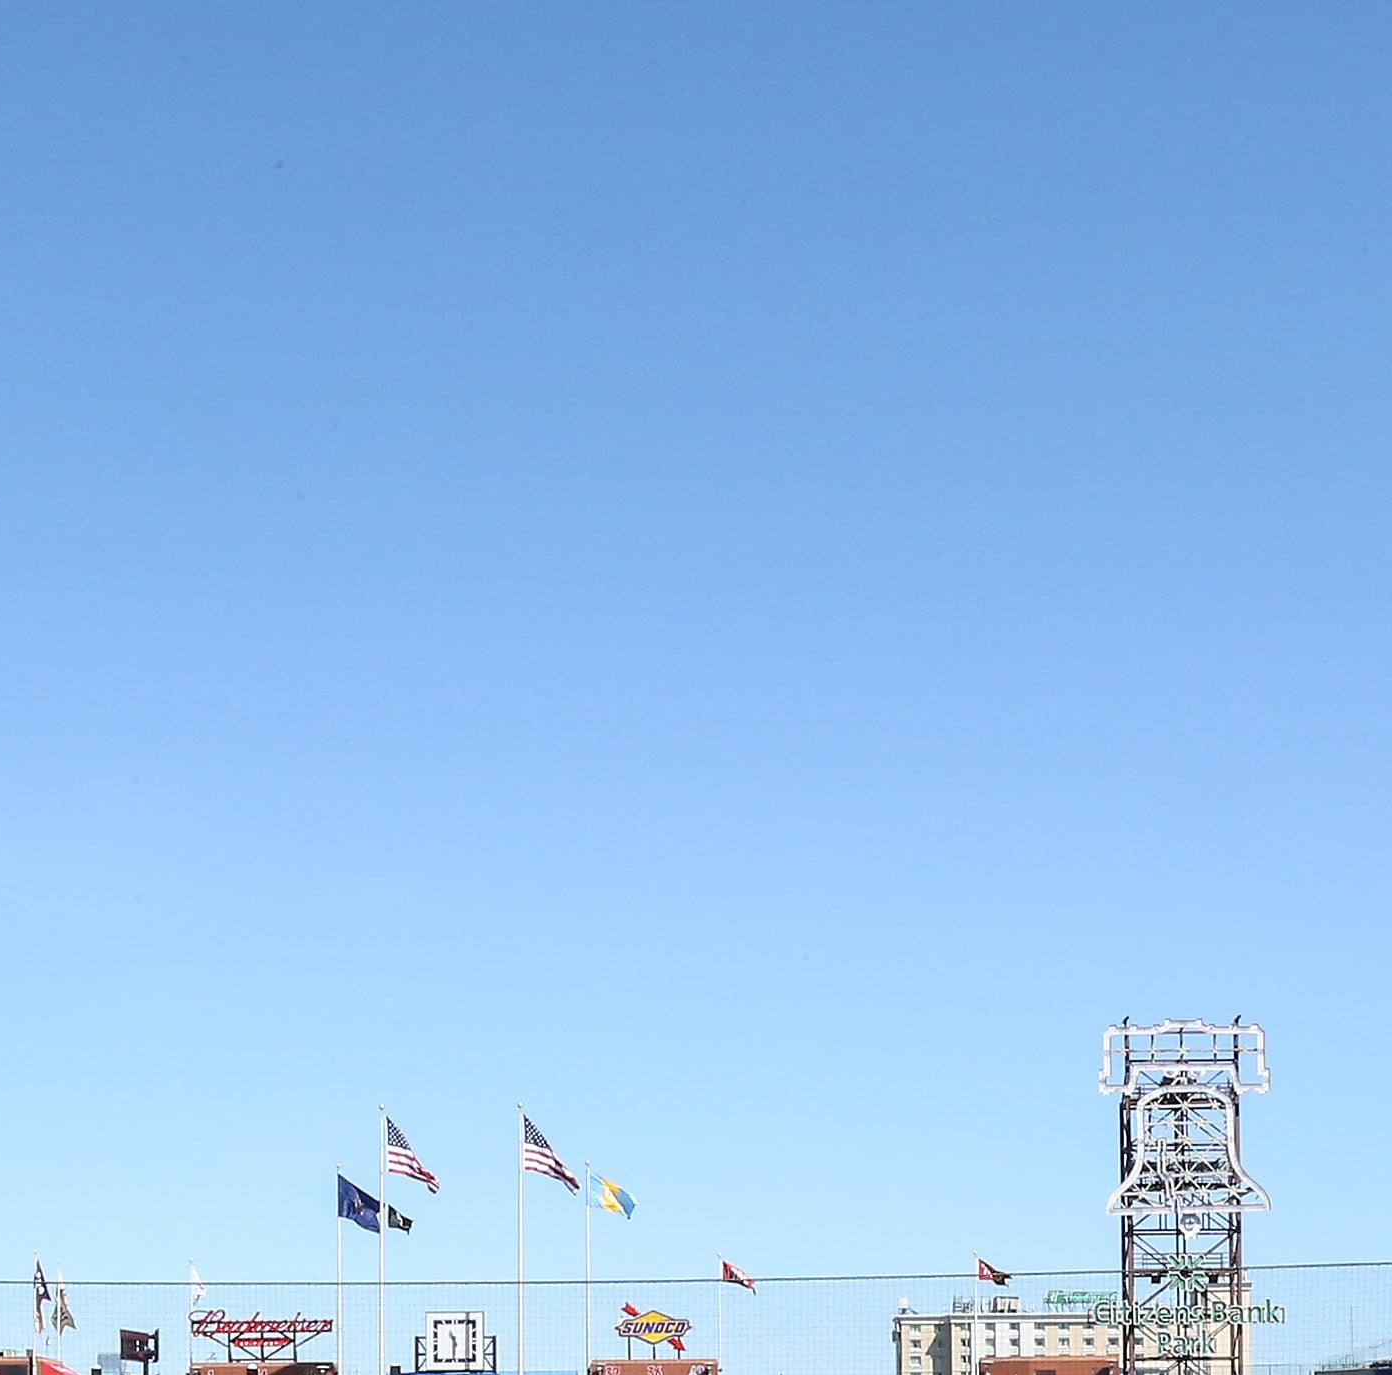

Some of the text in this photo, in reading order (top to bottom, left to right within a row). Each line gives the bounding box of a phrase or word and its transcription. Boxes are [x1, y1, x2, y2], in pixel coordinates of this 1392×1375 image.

[1093, 1298, 1280, 1325] Citizens Bank
[622, 1321, 686, 1335] SUNOCO
[1157, 1330, 1217, 1355] Park
